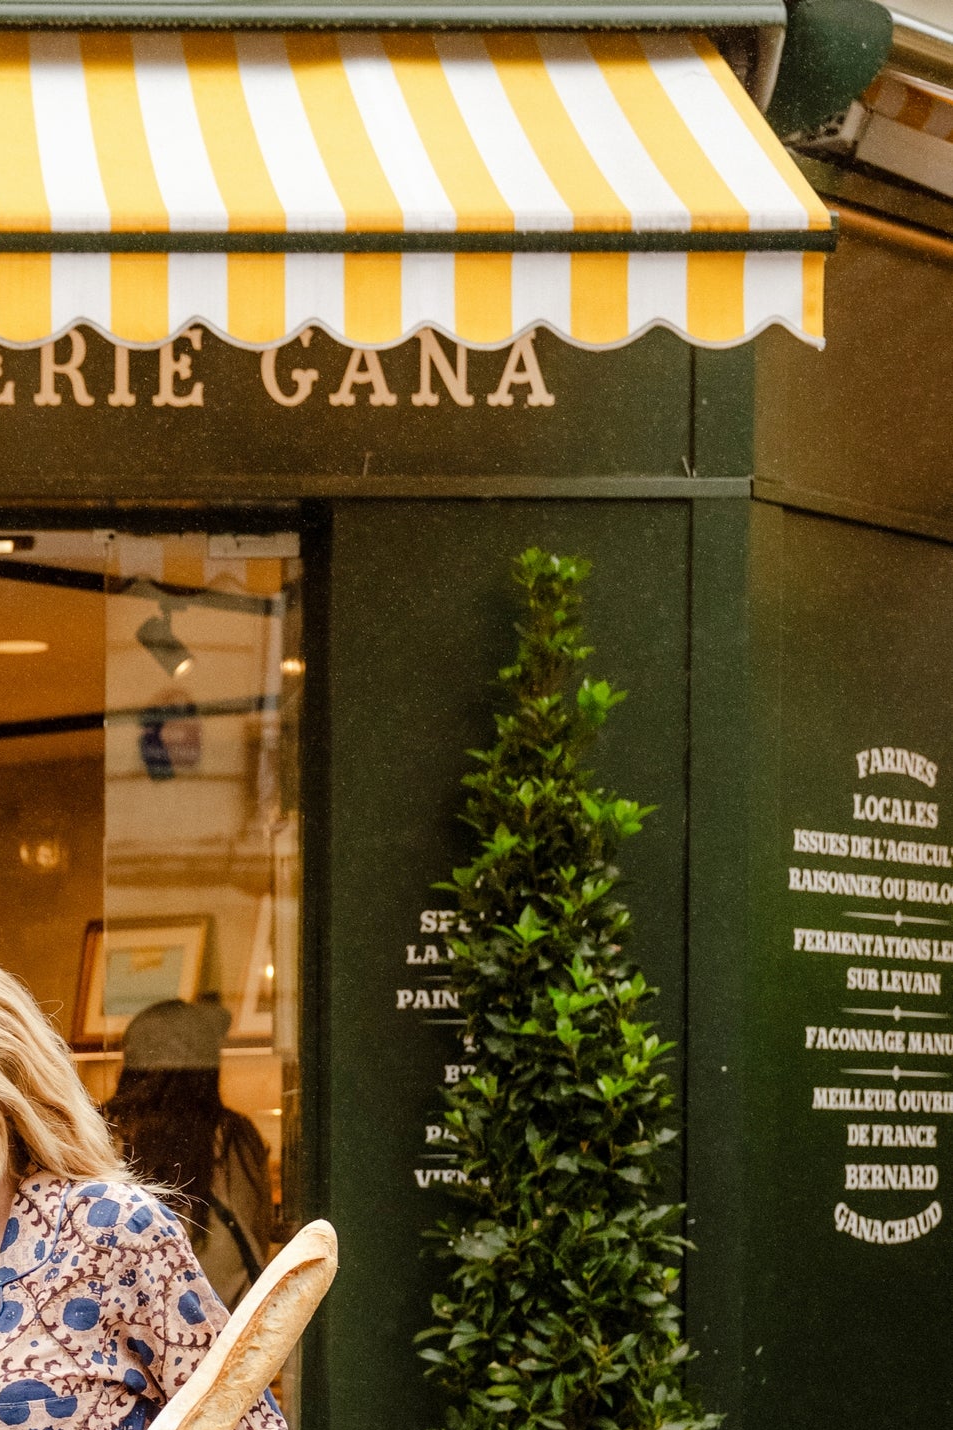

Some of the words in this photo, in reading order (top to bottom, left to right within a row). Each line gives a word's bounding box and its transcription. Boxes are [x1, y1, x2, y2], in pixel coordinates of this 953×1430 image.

[259, 325, 556, 406] GANA
[856, 747, 939, 788] FARINES
[853, 793, 939, 829] LOCALES
[793, 828, 849, 857] ISSUES
[850, 835, 873, 859] DE
[873, 837, 953, 868] L'AGRICUL
[788, 867, 882, 899] RAISONNEE
[883, 877, 905, 900] OU
[793, 928, 931, 961] FERMENTATIONS
[932, 940, 953, 963] LE
[847, 967, 879, 991] SUR
[881, 969, 941, 995] LEVAIN
[805, 1026, 906, 1053] FACONNAGE
[812, 1087, 897, 1112] MEILLEUR
[847, 1124, 870, 1146] DE
[871, 1124, 937, 1148] FRANCE
[845, 1164, 939, 1190] BERNARD
[834, 1201, 943, 1244] GANACHAUD
